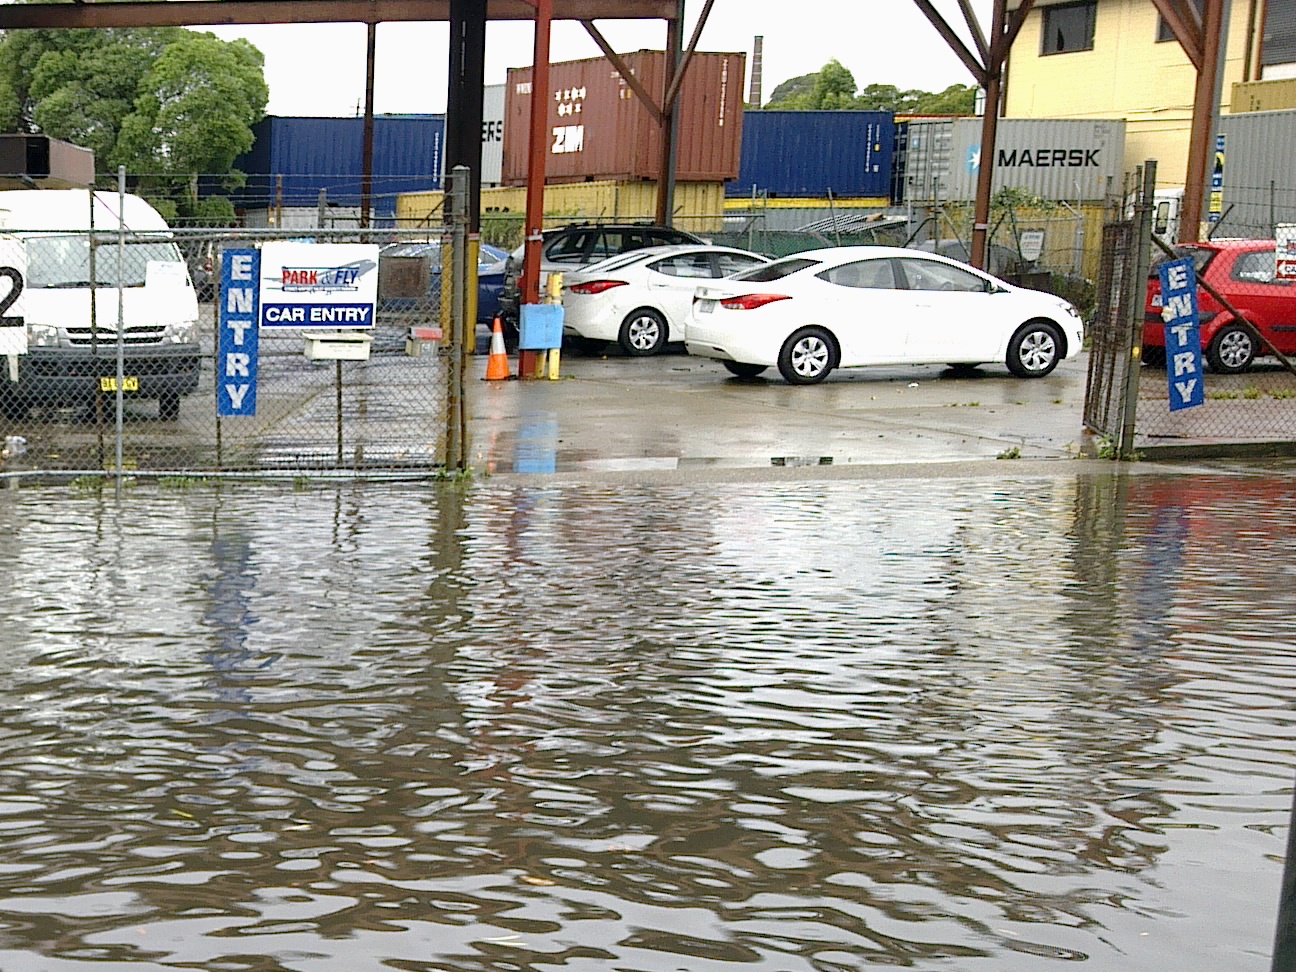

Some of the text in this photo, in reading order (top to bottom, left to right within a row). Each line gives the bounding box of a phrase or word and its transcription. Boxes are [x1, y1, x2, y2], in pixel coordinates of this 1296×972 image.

[481, 121, 502, 142] ERS
[998, 149, 1101, 167] MAERSK
[282, 270, 359, 285] PARK & FLY
[265, 307, 370, 322] CAR ENTRY
[224, 255, 253, 410] ENTRY
[1167, 265, 1197, 403] ENTRY
